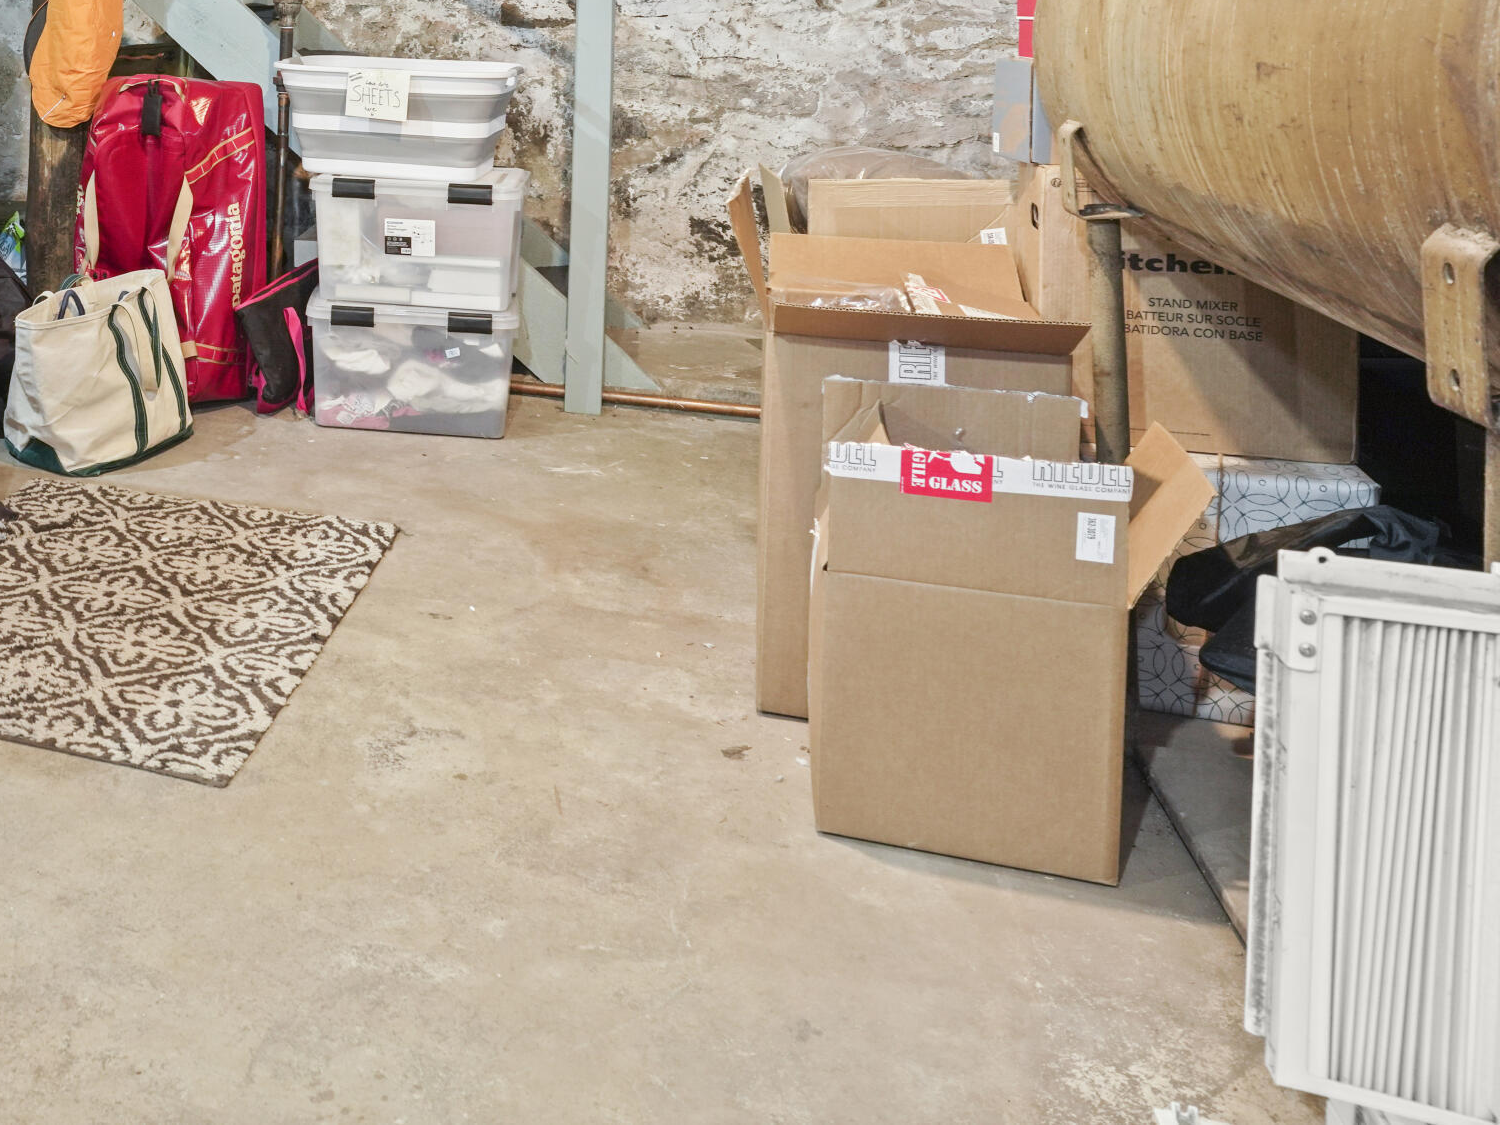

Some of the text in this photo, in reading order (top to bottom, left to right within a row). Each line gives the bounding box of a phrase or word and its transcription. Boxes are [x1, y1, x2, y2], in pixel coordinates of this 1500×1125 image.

[349, 84, 401, 108] SHEETS
[226, 201, 246, 308] patagonia
[1148, 297, 1238, 312] STAND MIXER
[1127, 309, 1261, 328] BATTEUR SUR SOCLE
[1124, 323, 1263, 342] BATIDORA CON BASE
[928, 476, 983, 494] GLASS
[1047, 483, 1066, 491] WINE
